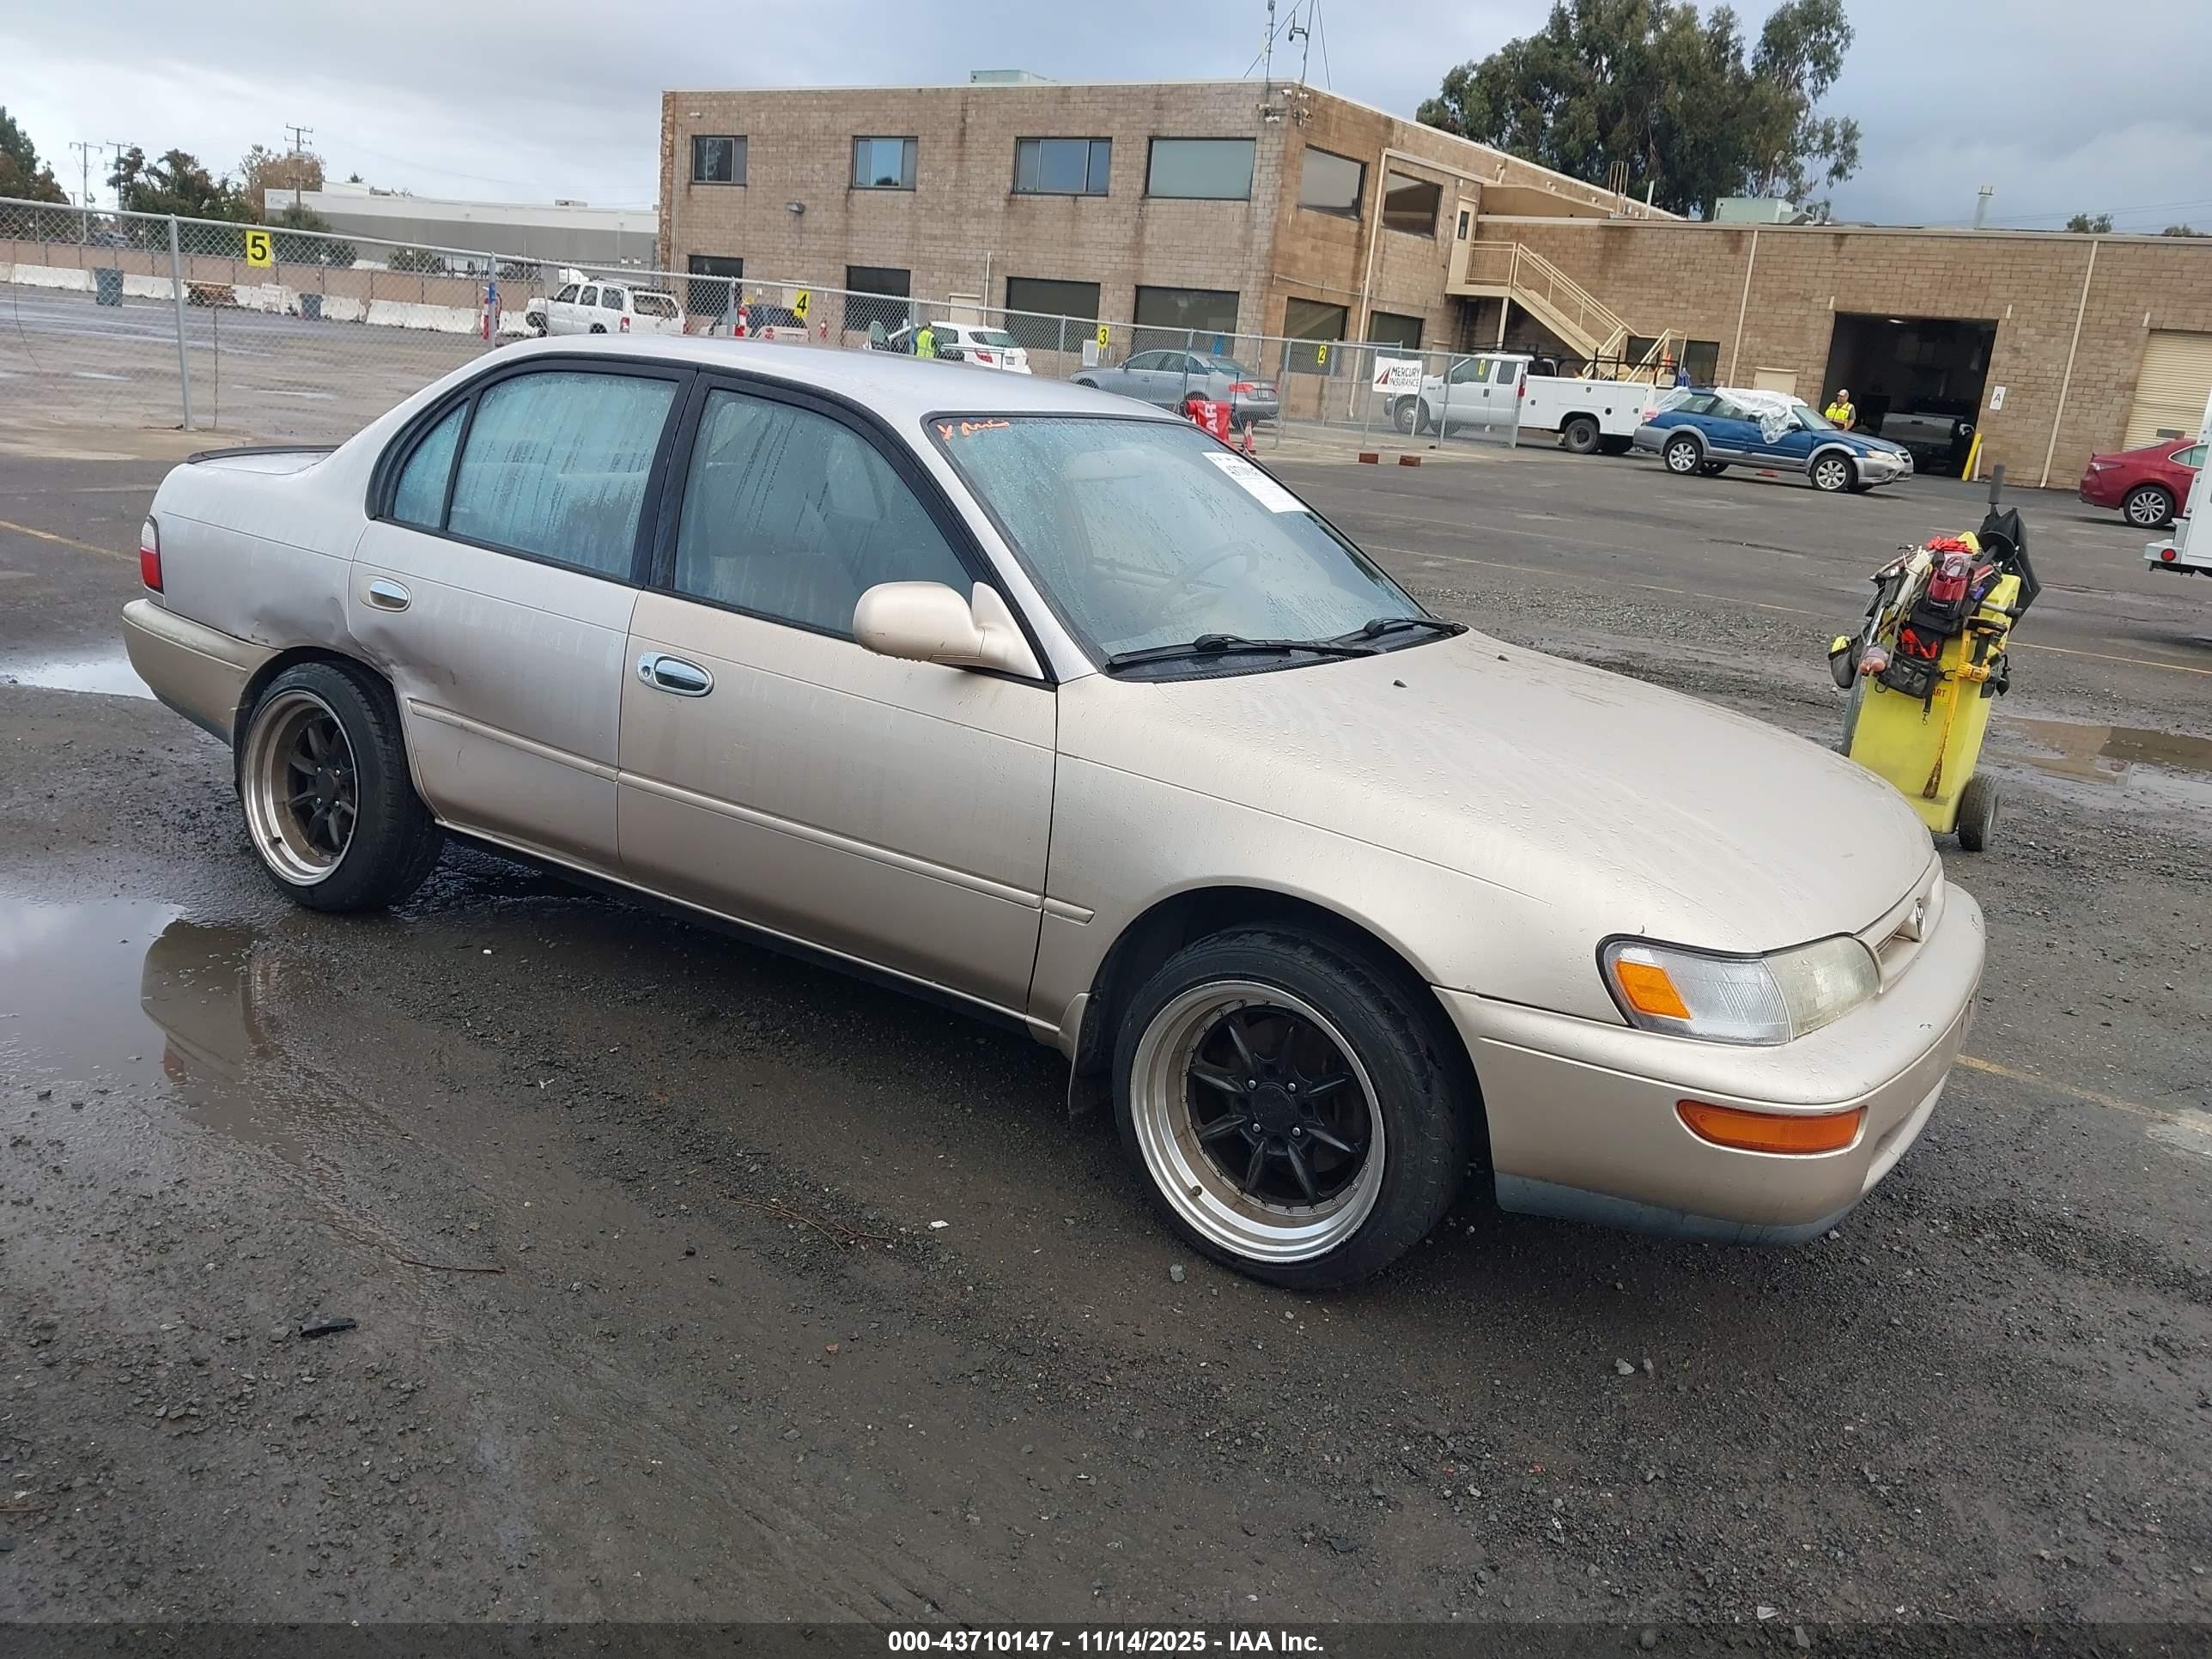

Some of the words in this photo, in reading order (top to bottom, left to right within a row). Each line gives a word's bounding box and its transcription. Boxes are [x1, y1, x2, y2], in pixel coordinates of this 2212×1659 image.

[251, 234, 267, 261] 5
[796, 294, 808, 313] 4
[1099, 328, 1107, 345] 3
[1318, 346, 1326, 361] 2
[1391, 366, 1421, 378] MERCURY
[1389, 378, 1419, 387] INSURANCE
[1993, 392, 2001, 403] A
